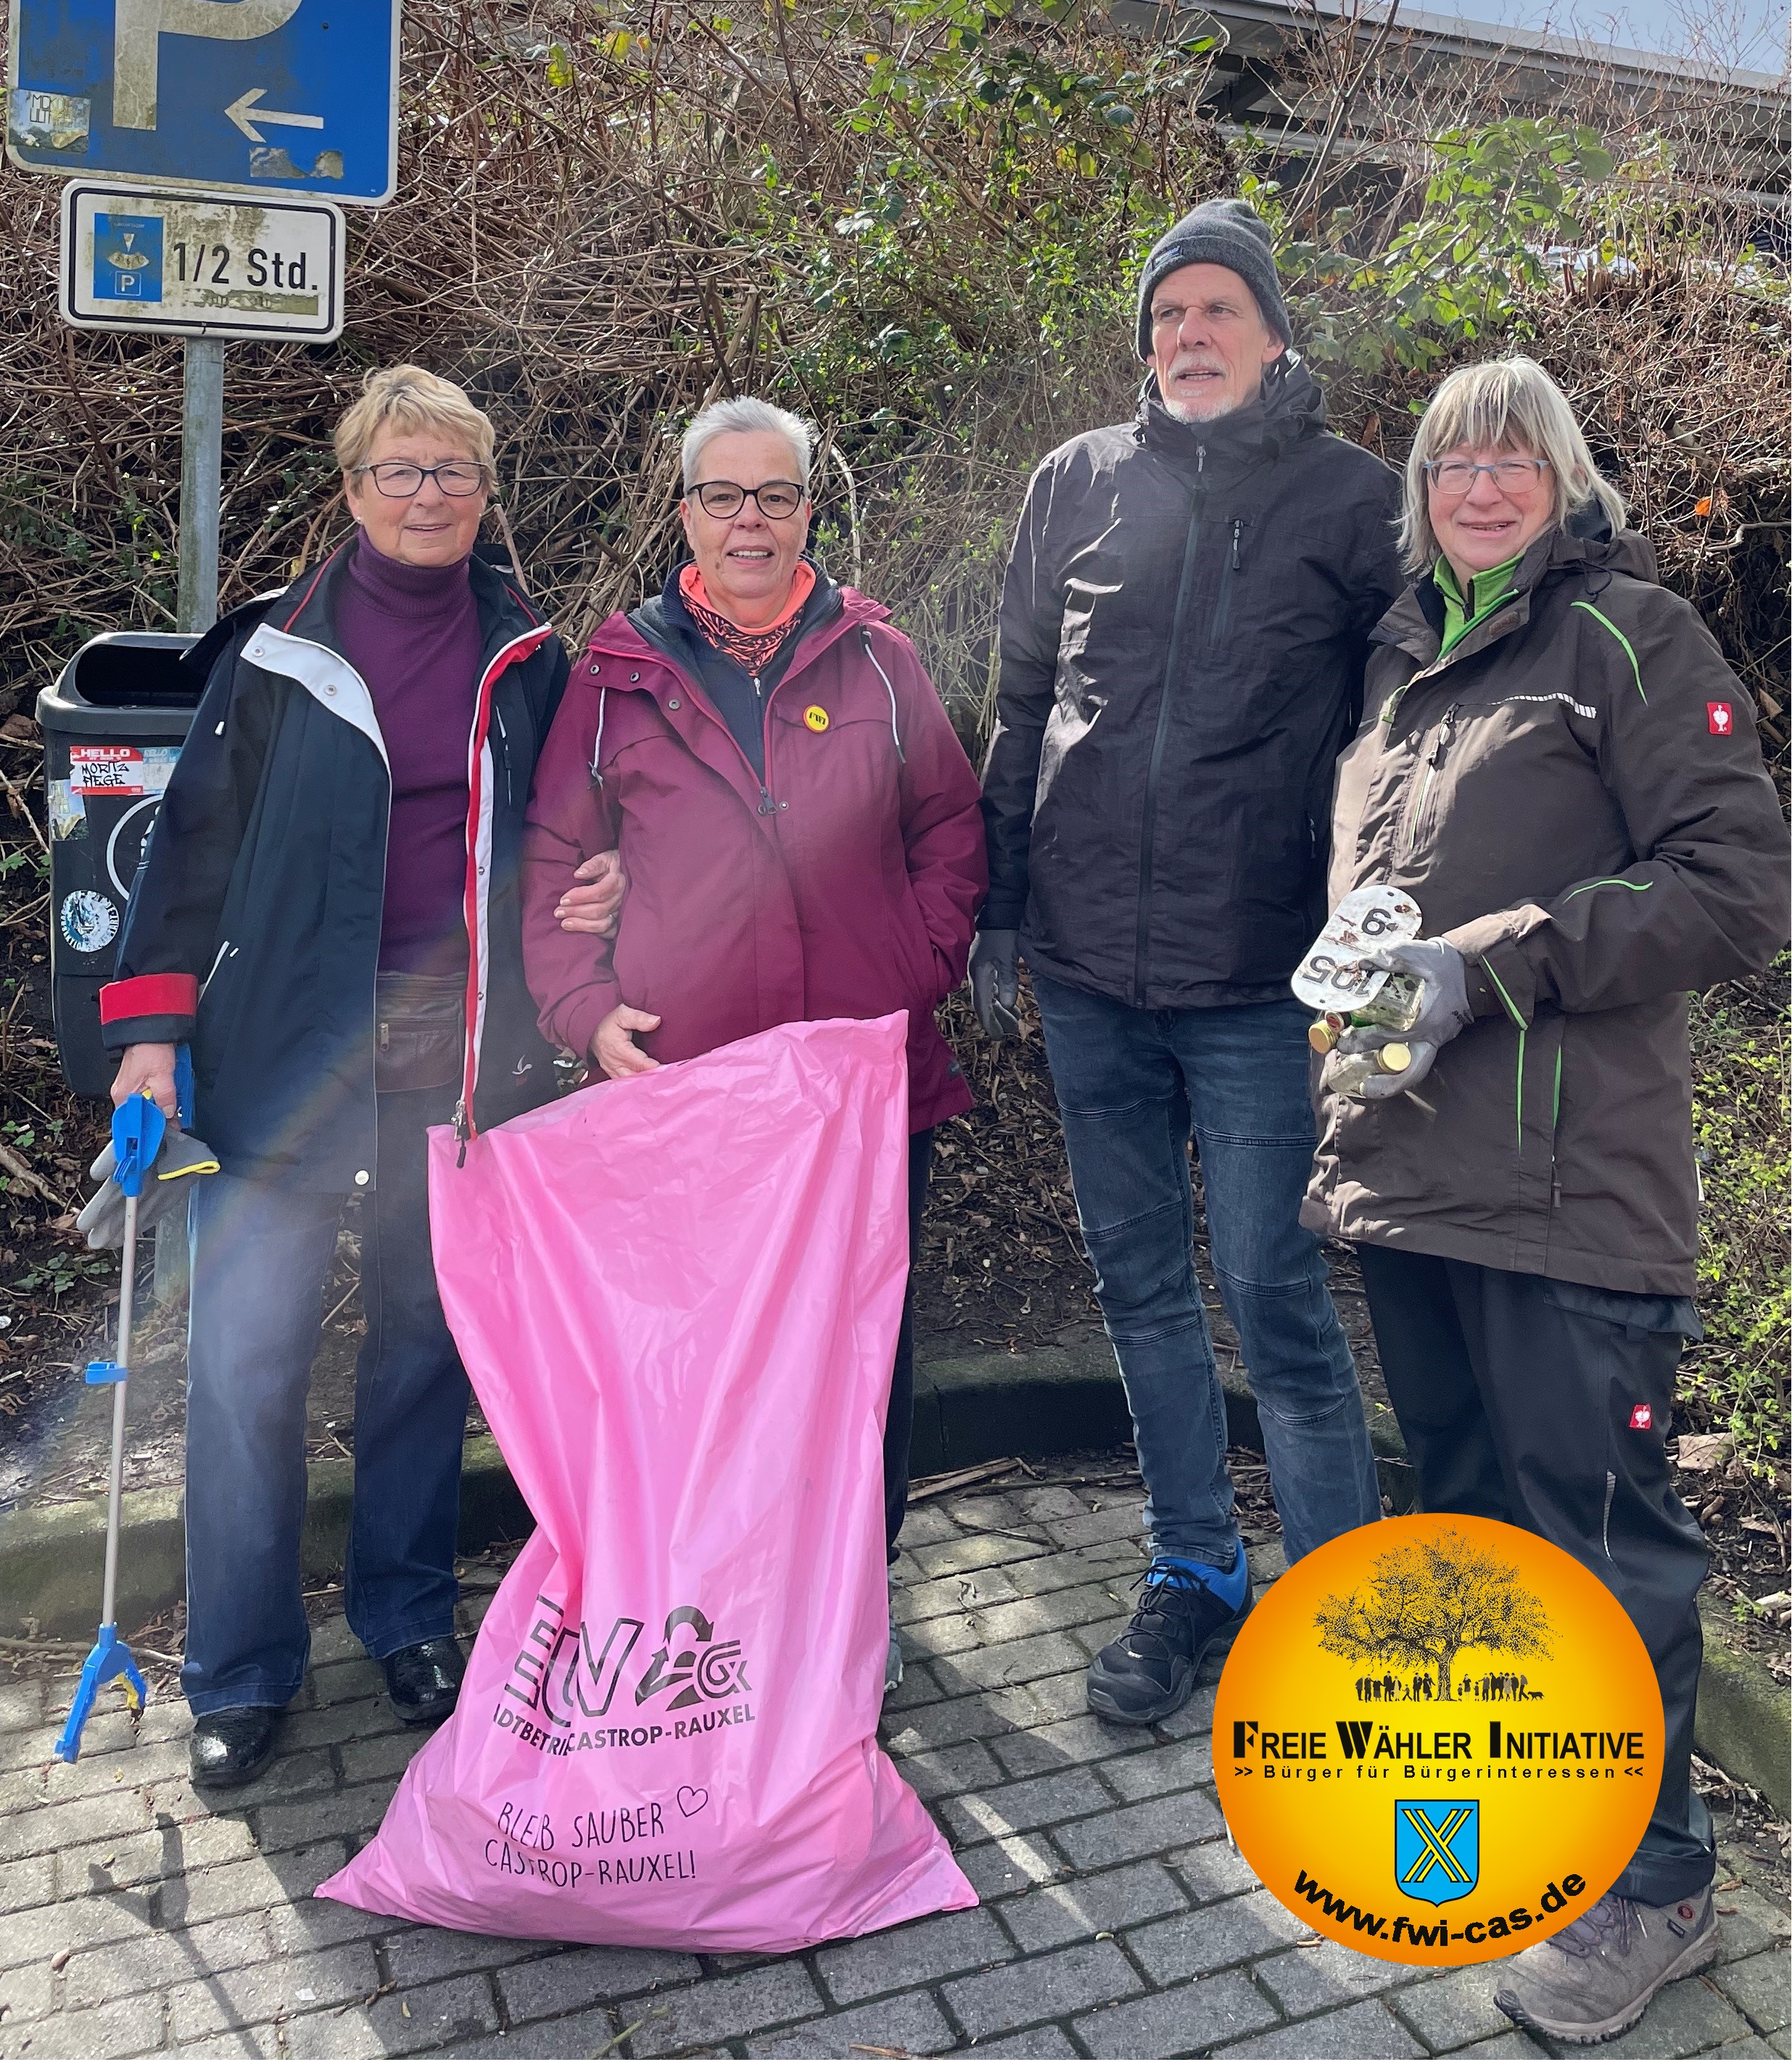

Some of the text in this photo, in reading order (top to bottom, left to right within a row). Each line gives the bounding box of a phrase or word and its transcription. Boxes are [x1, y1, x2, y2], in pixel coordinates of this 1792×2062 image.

[120, 274, 136, 293] P
[173, 242, 318, 291] 1/2 Std.
[80, 748, 131, 758] HELLO
[567, 1703, 756, 1753] CASTROP-RAUXEL
[571, 1802, 664, 1849] SAUBER
[484, 1839, 697, 1889] CASTROP-RAUXEL!
